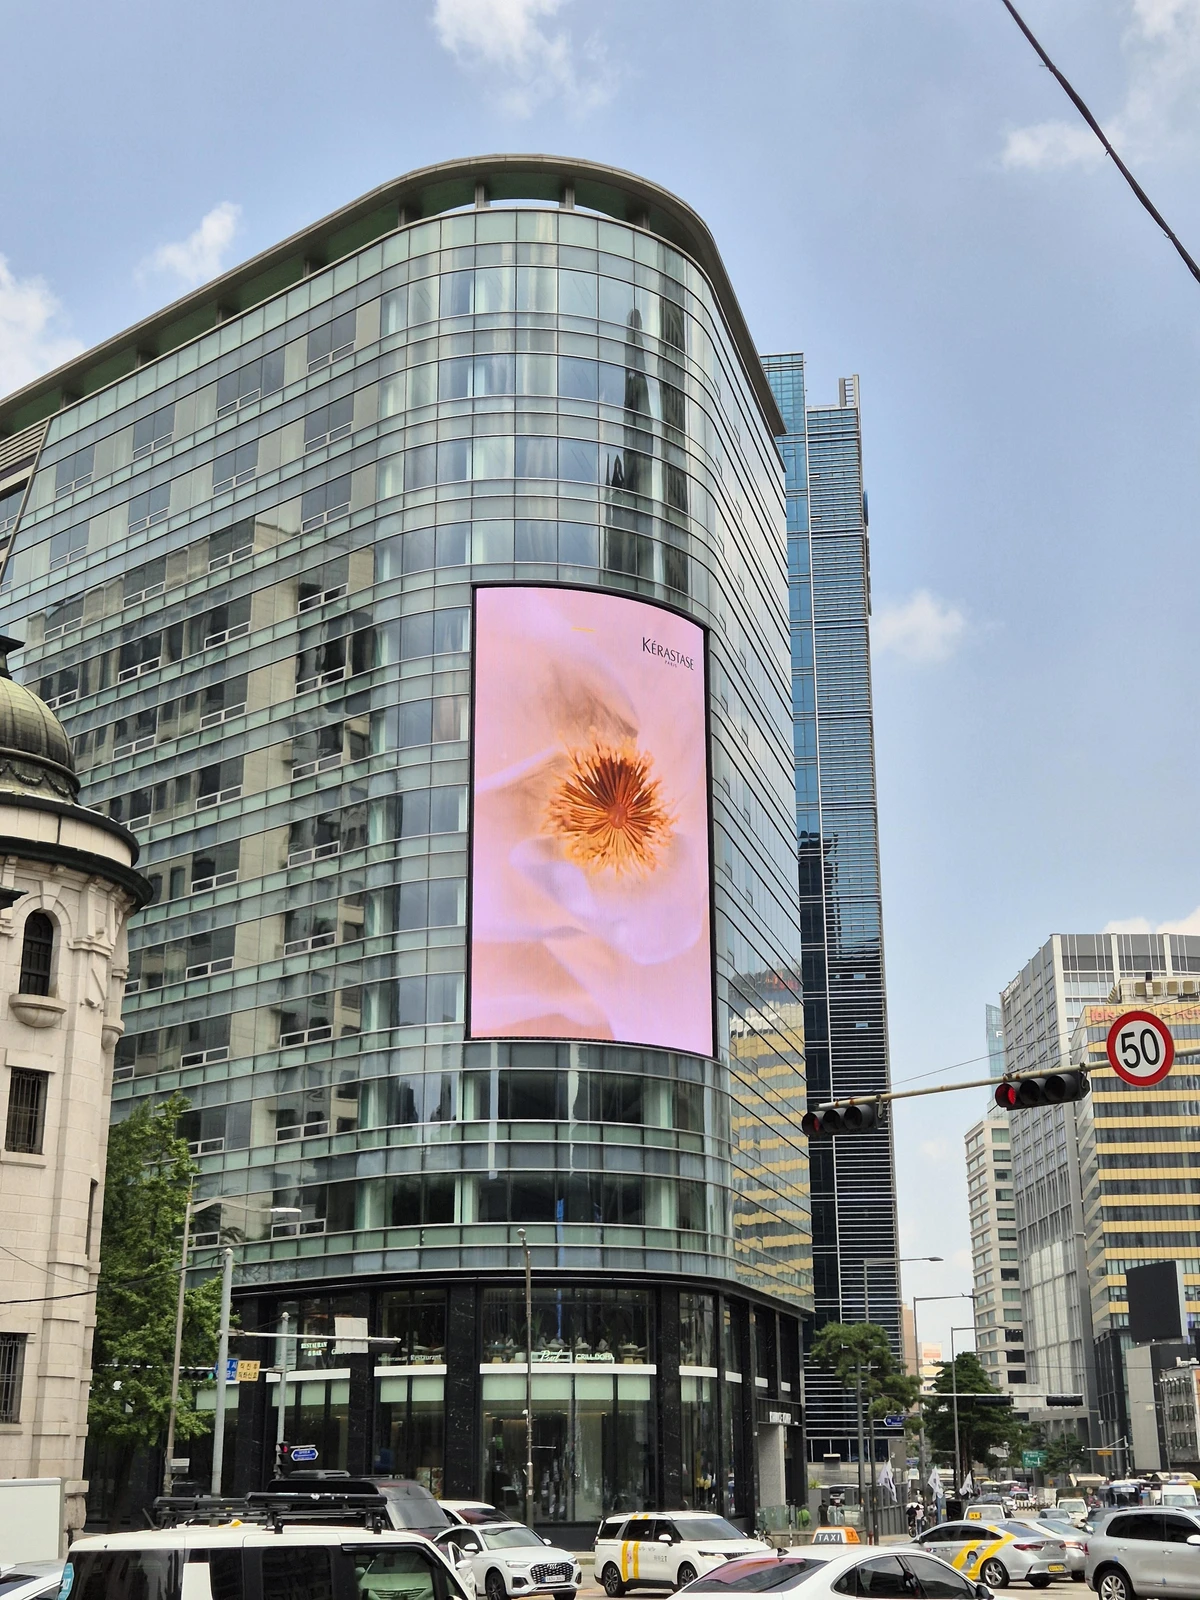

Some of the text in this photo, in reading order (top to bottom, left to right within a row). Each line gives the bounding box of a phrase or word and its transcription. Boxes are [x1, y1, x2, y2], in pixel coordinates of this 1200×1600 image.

[642, 636, 694, 670] KÉRASTASE
[1121, 1028, 1160, 1069] 50
[818, 1534, 840, 1542] TAXI
